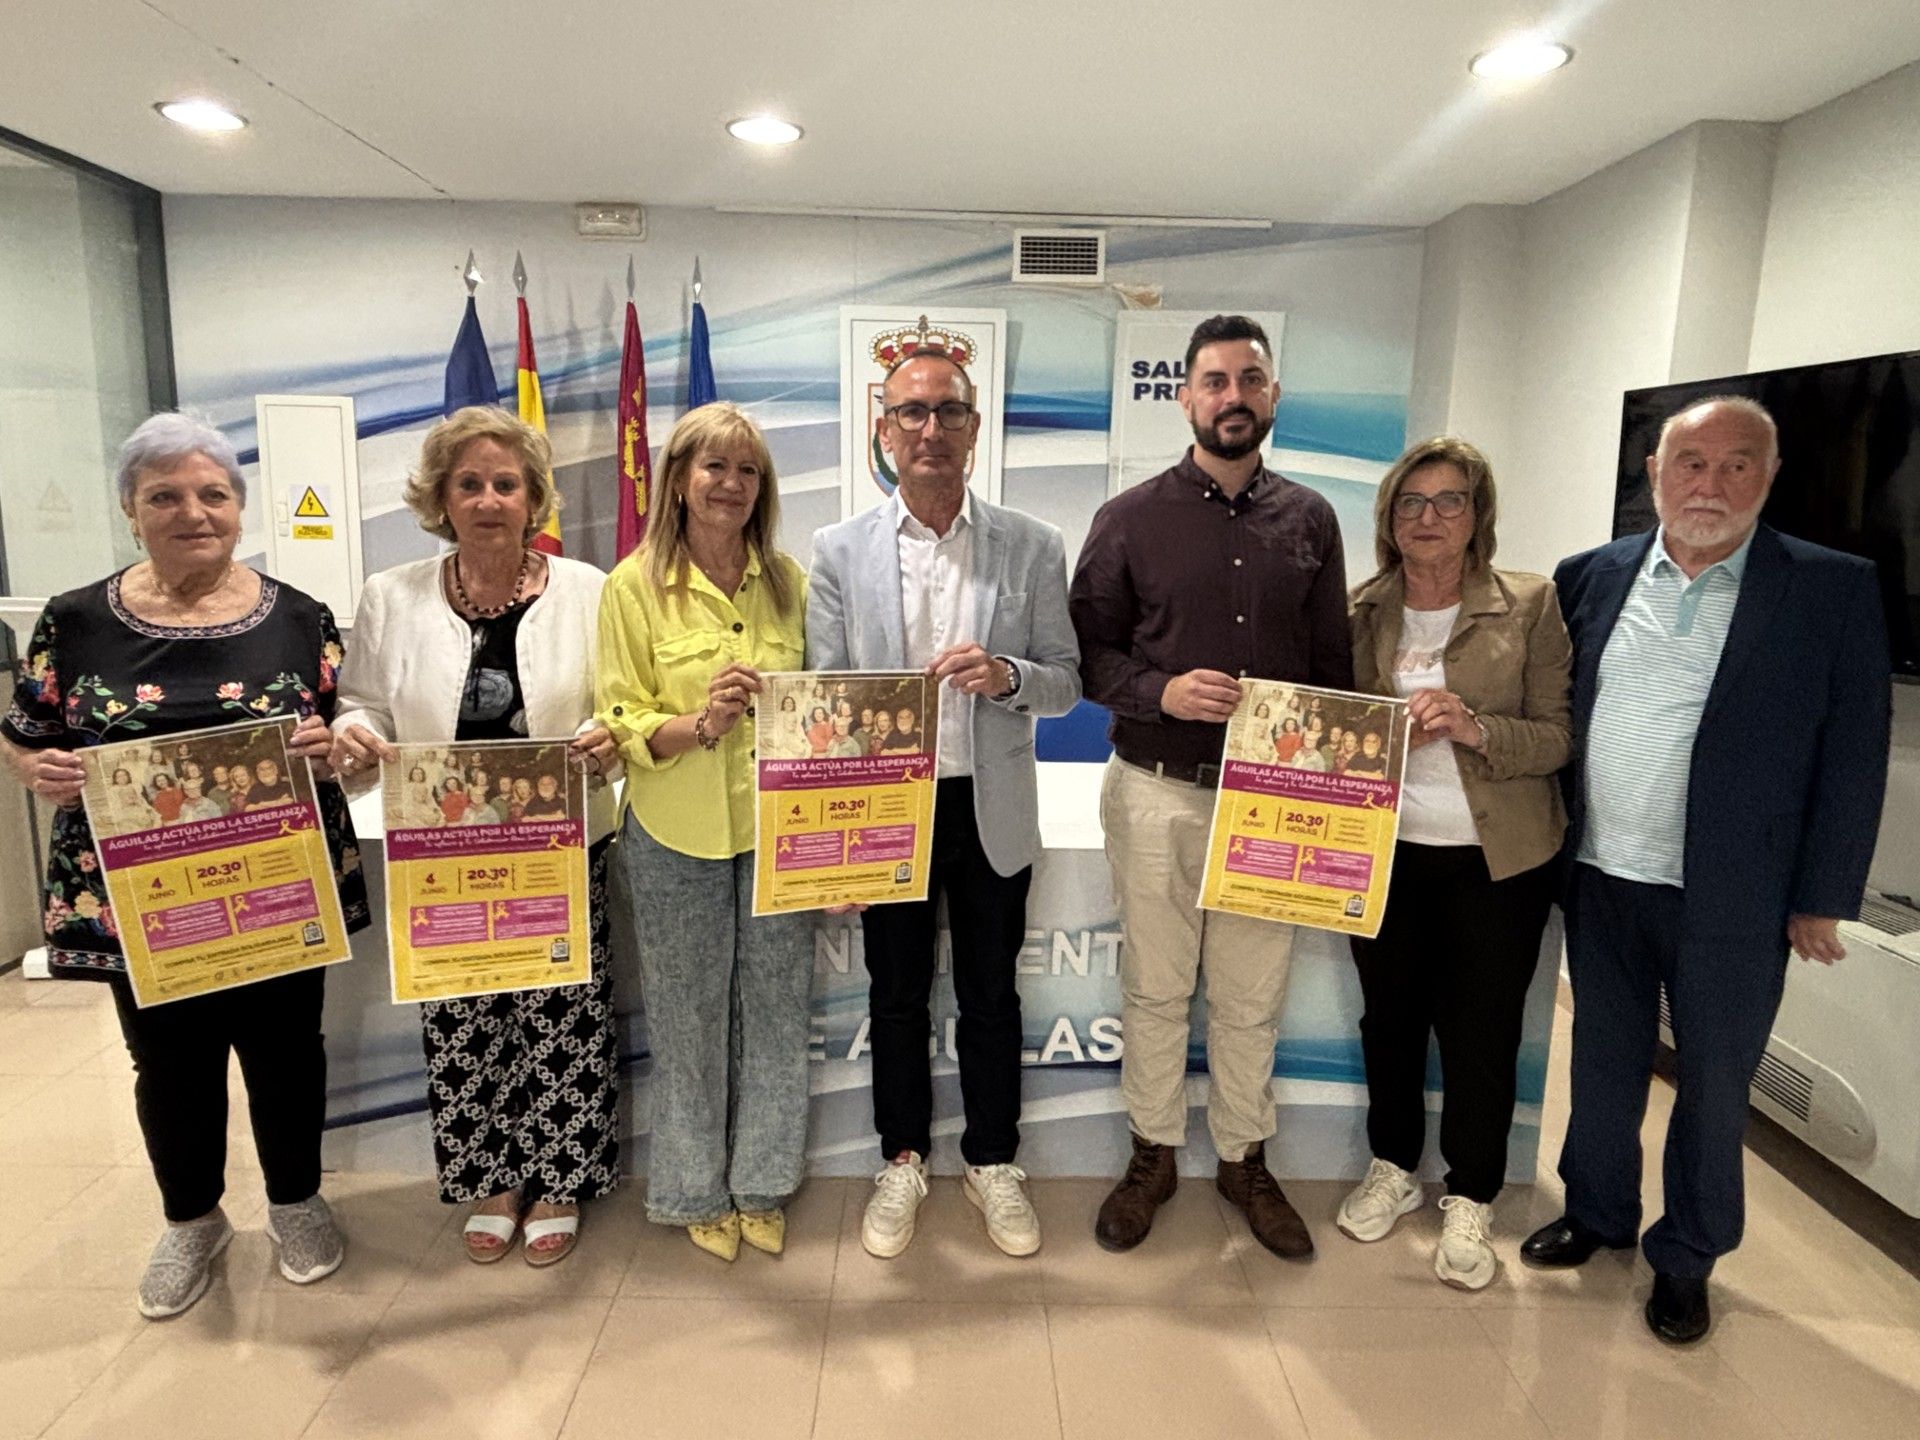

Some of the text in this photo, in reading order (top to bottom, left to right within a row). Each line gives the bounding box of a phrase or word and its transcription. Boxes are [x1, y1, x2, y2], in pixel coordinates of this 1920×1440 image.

[765, 762, 807, 772] ÁGUILAS
[809, 761, 841, 770] ACTÚA
[864, 760, 874, 768] LA
[878, 757, 928, 768] ESPERANZA
[1230, 764, 1270, 777] ÁGUILAS
[1272, 770, 1303, 781] ACTÚA
[1305, 775, 1324, 784] POR
[1326, 778, 1338, 786] LA
[1340, 780, 1392, 796] ESPERANZA
[792, 805, 800, 815] 4
[829, 800, 865, 810] 20.30
[831, 812, 861, 820] HORAS
[1249, 807, 1258, 817] 4
[1285, 813, 1323, 826] 20.30
[108, 833, 160, 851] ÁGUILAS
[162, 826, 200, 841] ACTÚA
[203, 822, 225, 833] POR
[228, 818, 243, 828] LA
[245, 806, 308, 824] ESPERANZA
[503, 826, 516, 835] LA
[196, 862, 241, 878] 20.30
[152, 878, 162, 888] 4
[203, 875, 240, 888] HORAS
[148, 889, 175, 900] JUNIO
